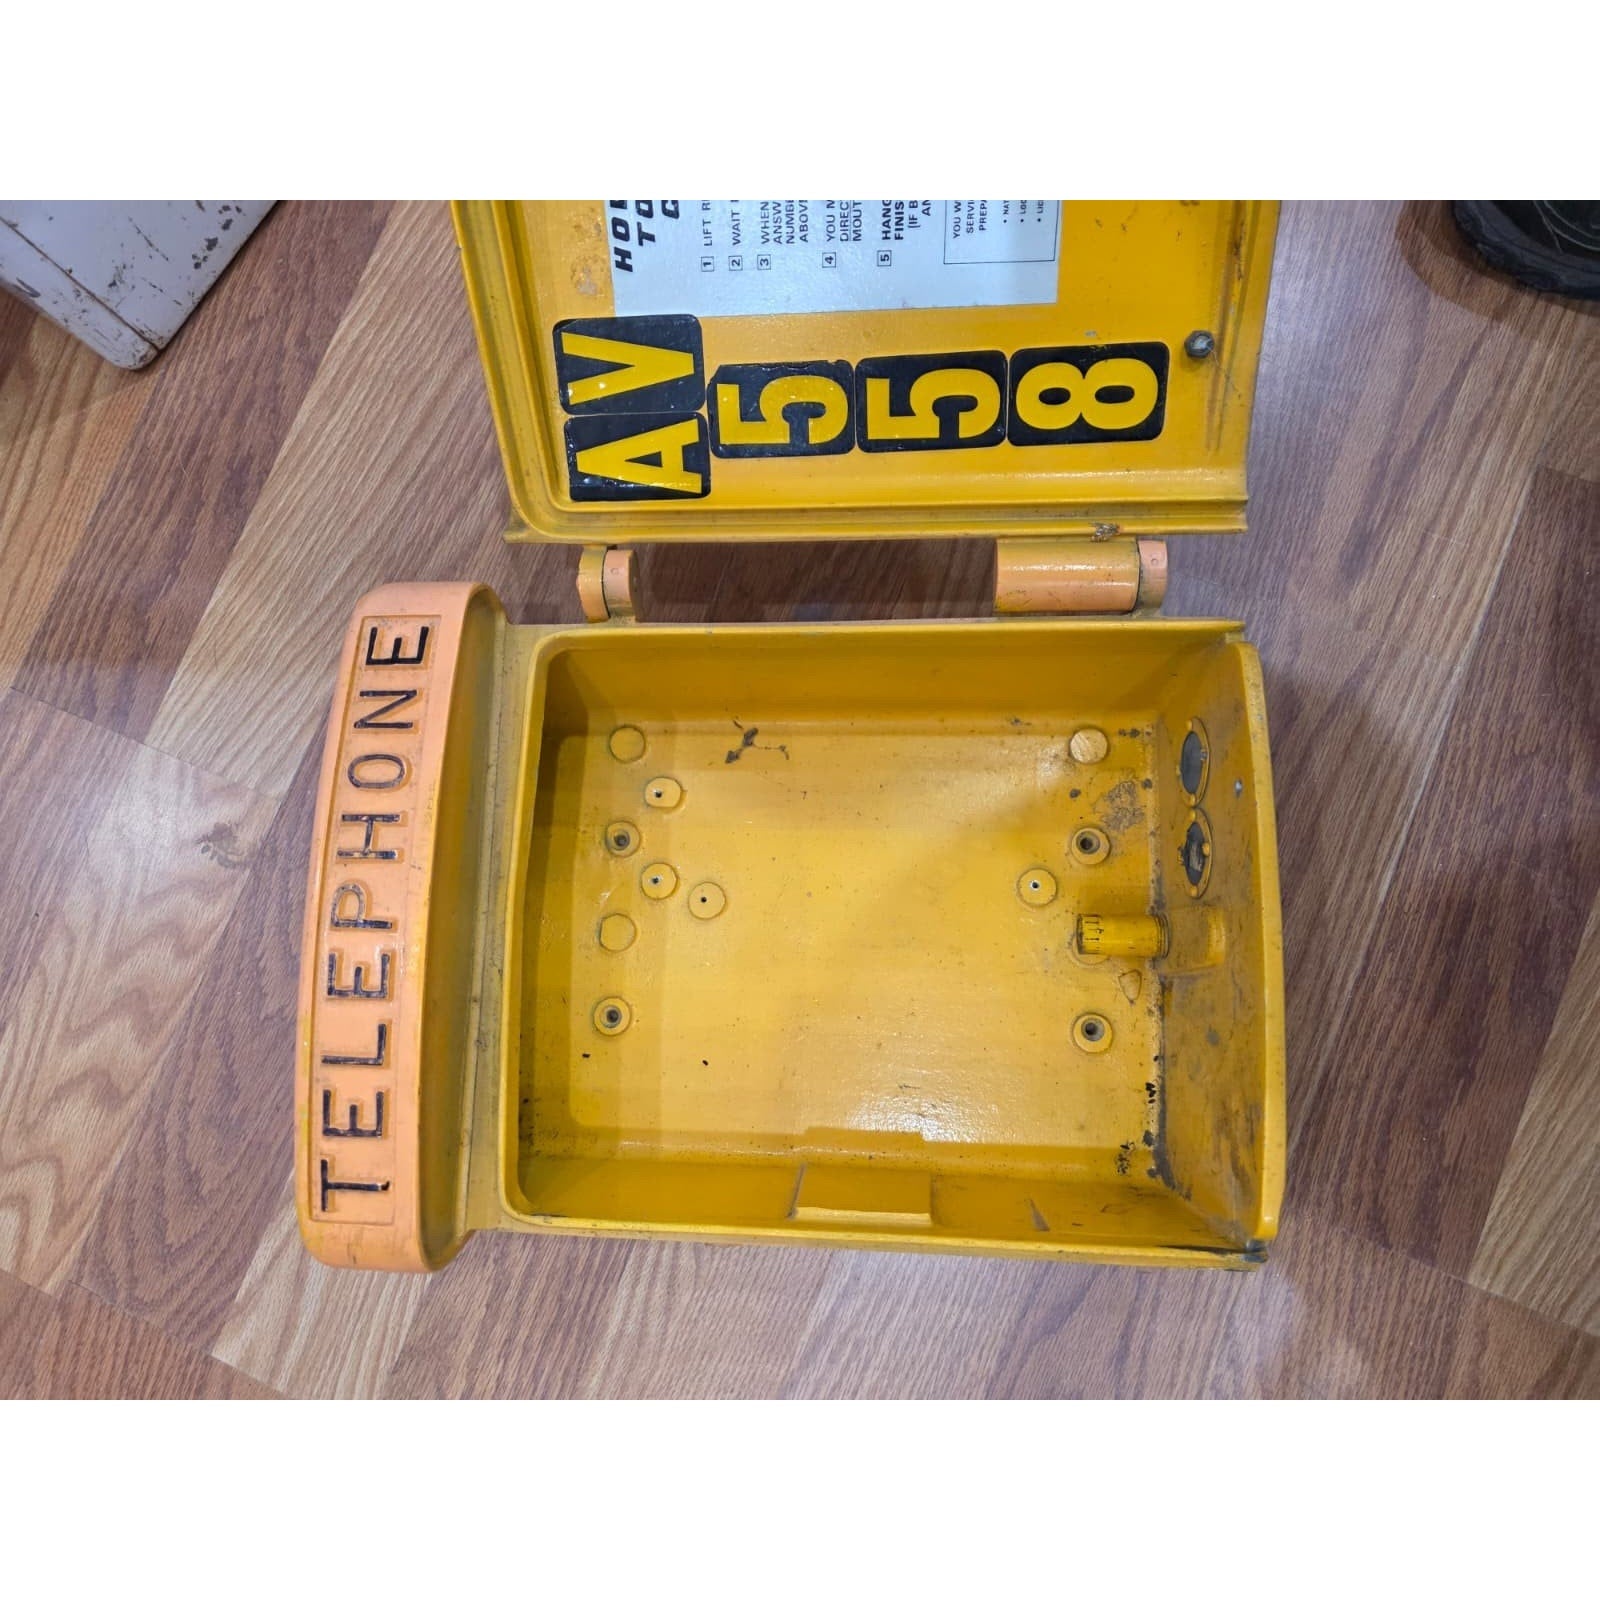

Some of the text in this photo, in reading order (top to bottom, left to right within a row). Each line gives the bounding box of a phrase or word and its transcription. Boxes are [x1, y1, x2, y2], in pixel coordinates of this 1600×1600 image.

[702, 219, 713, 247] LIFT
[731, 210, 741, 246] WAIT
[760, 201, 770, 245] WHEN
[772, 201, 783, 245] ANSW
[785, 200, 795, 245] NUMB
[826, 215, 836, 242] YOU
[839, 200, 849, 242] DIREC
[852, 200, 862, 242] MOUT
[894, 201, 905, 241] FINIS
[952, 216, 961, 239] YOU
[966, 200, 975, 234] SERVI
[561, 332, 703, 494] AV
[321, 626, 430, 1212] TELEPHONE
